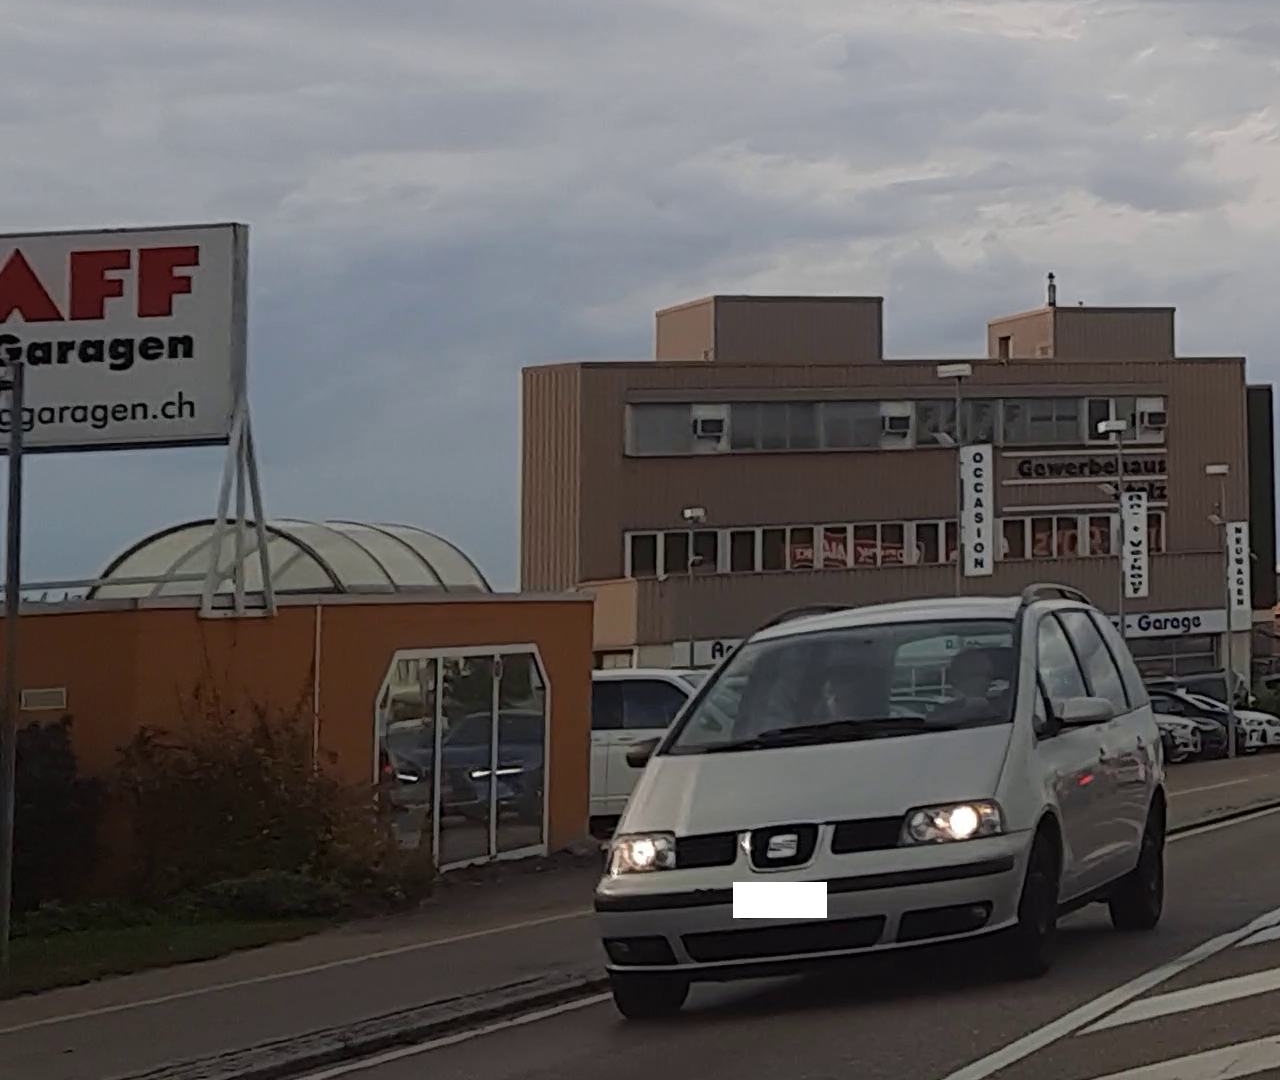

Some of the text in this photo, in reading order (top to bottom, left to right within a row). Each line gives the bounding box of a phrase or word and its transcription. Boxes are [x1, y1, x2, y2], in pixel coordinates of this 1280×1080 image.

[0, 334, 194, 371] Garagen
[972, 451, 985, 569] OCCASION
[1138, 615, 1202, 635] Garage
